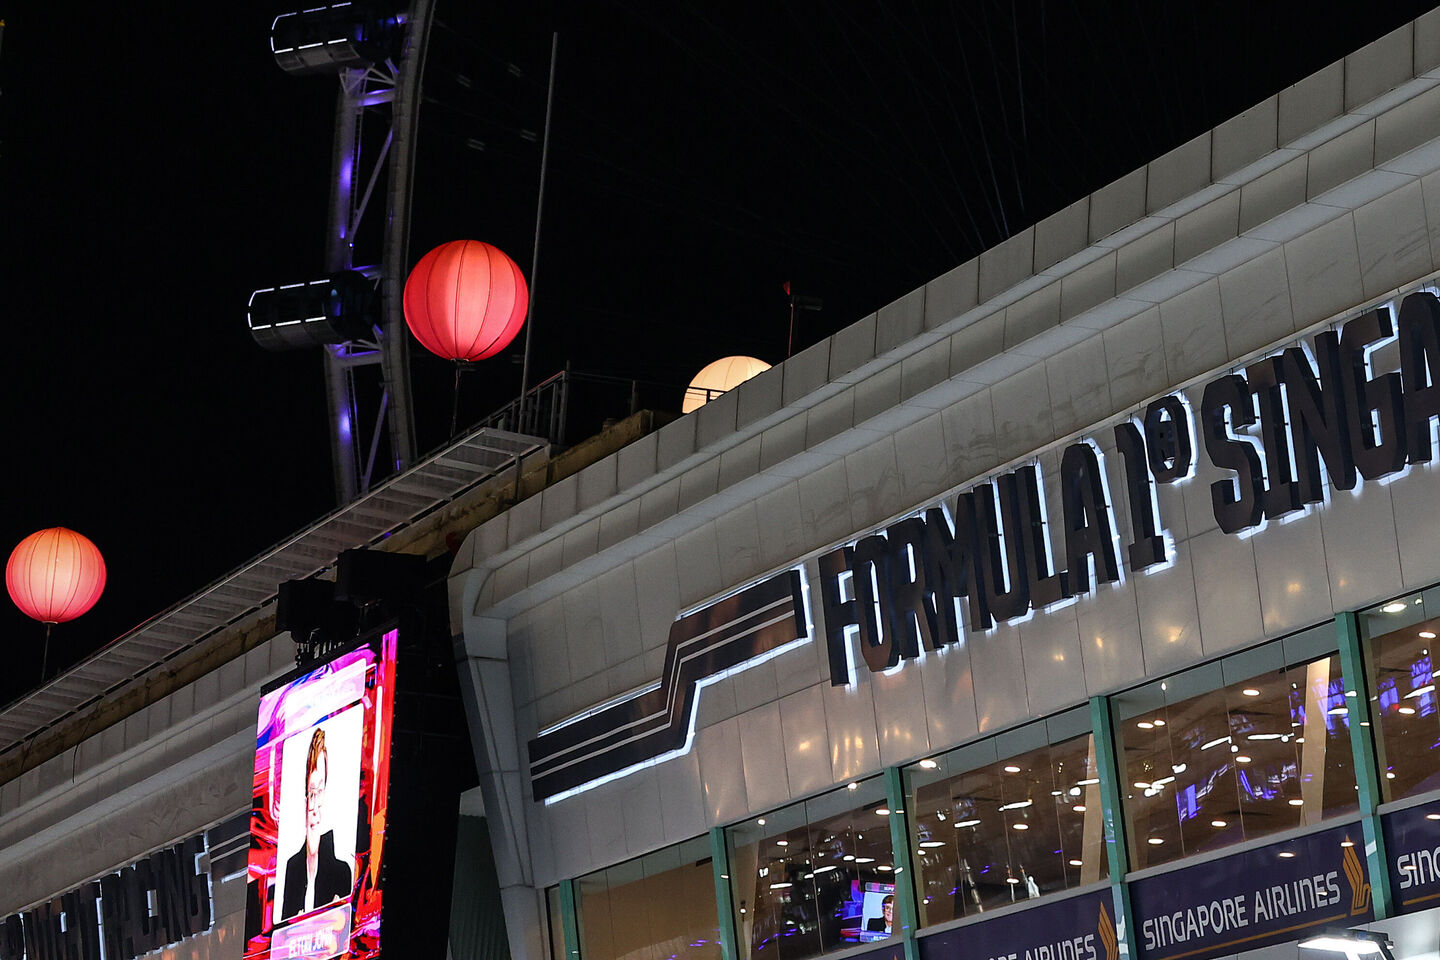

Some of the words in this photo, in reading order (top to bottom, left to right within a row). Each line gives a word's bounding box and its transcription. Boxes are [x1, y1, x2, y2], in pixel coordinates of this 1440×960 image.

[818, 443, 1119, 687] FORMULA
[1143, 895, 1249, 951] SINGAPORE
[1254, 871, 1341, 923] AIRLINES
